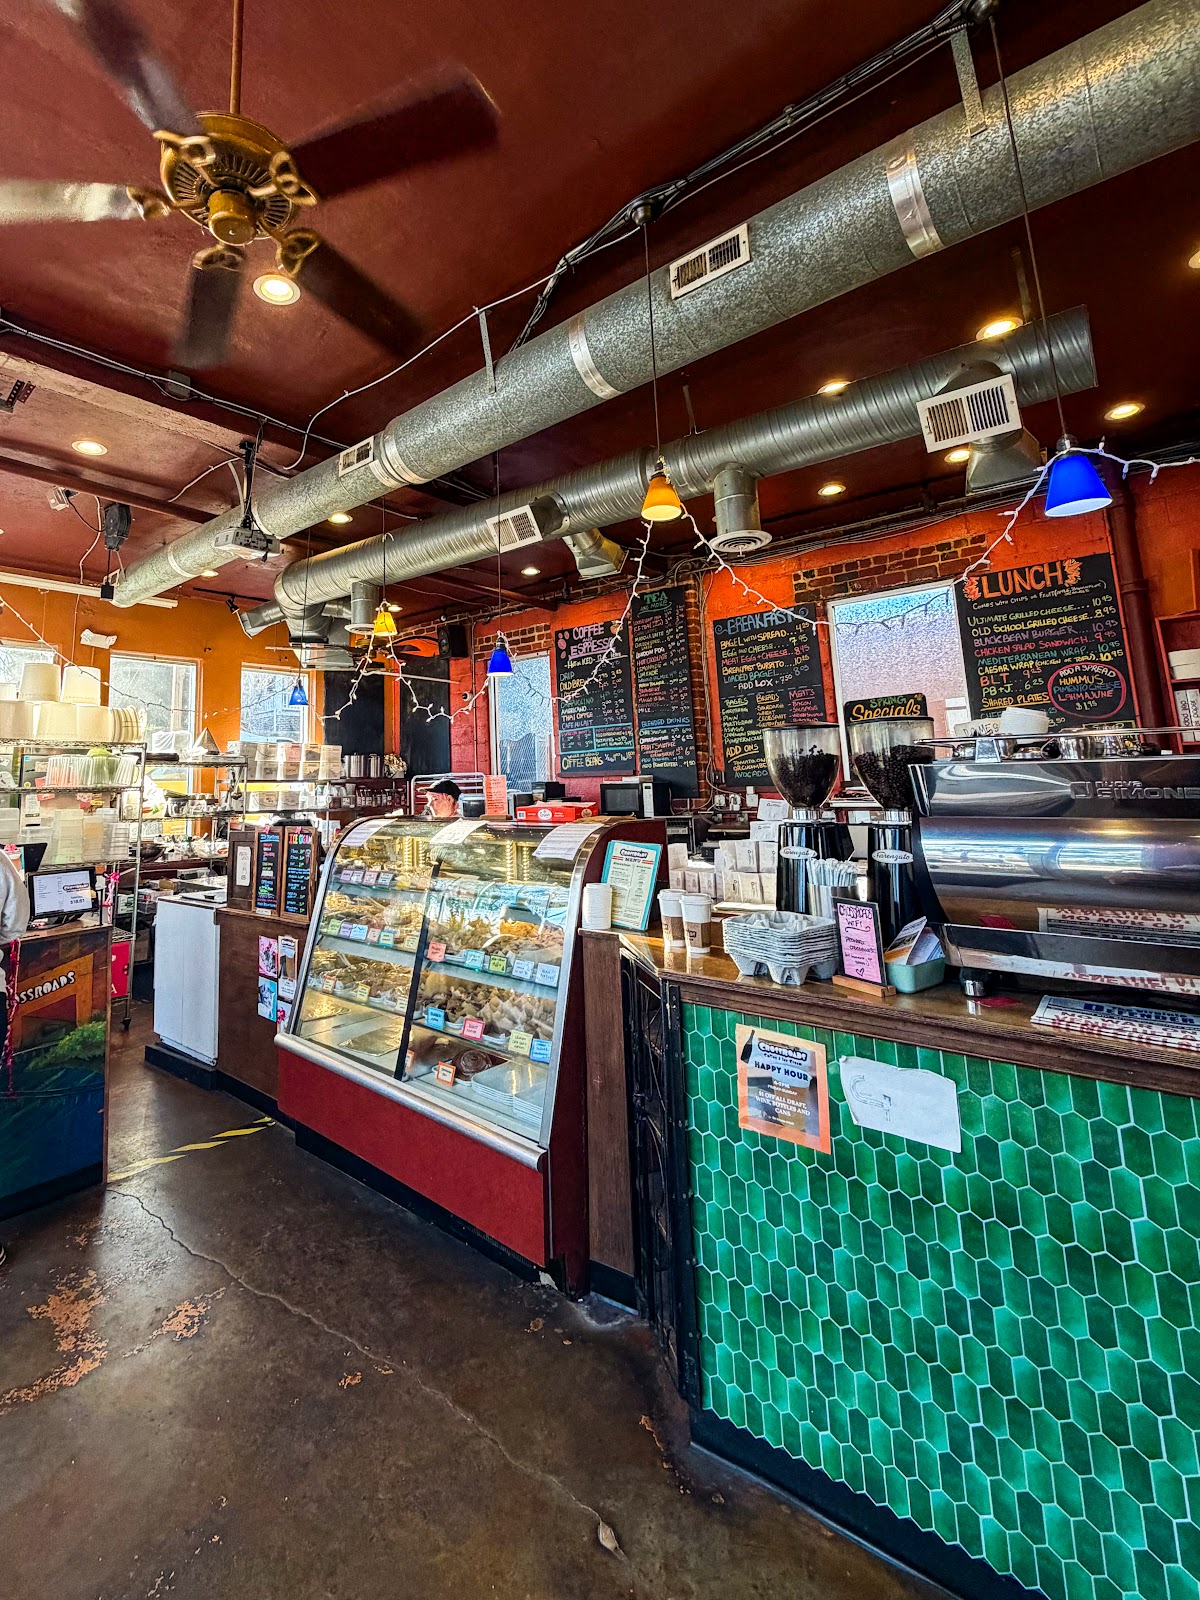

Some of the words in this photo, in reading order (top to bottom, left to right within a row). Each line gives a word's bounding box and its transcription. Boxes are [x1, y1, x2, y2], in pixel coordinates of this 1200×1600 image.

[982, 561, 1064, 598] LUNCH
[644, 591, 668, 604] TEA
[727, 608, 796, 635] BREAKFAST
[967, 614, 1008, 626] ULTIMATE
[1009, 610, 1039, 620] GRILLED
[572, 622, 604, 640] COFFEE
[972, 626, 991, 637] OLD
[993, 622, 1027, 633] SCHOOL
[1027, 617, 1058, 628] GRILLED
[720, 636, 744, 650] BAGEL
[758, 630, 787, 642] SPREAD
[974, 635, 1002, 647] BLACK
[1002, 630, 1029, 643] BEAN
[1032, 625, 1078, 639] BURGER
[721, 648, 738, 658] EGG
[748, 643, 774, 654] CHEESE
[974, 645, 1010, 658] CHICKEN
[1012, 642, 1036, 652] SALAD
[1039, 636, 1088, 649] SANDWICH
[721, 656, 739, 667] MEAT
[978, 650, 1057, 666] MEDITERRANEAN
[1060, 645, 1086, 656] WRAP
[722, 664, 756, 676] BREAKFAST
[756, 660, 784, 670] BURRITO
[978, 664, 1010, 676] CAESAR
[1010, 660, 1034, 671] WRAP
[1059, 668, 1074, 678] ADD
[1082, 664, 1116, 678] SPREAD
[723, 674, 748, 684] LOADED
[748, 669, 780, 680] BAGEL
[738, 682, 754, 690] ADD
[754, 678, 774, 688] LOX
[980, 672, 1010, 687] BLT
[1059, 674, 1104, 686] HUMMUS
[560, 681, 572, 692] COLD
[1053, 684, 1088, 694] PIMENTO
[1089, 681, 1122, 690] CHEESE
[788, 689, 816, 700] MEATS
[870, 696, 907, 708] SPRING
[982, 696, 1014, 708] SHARED
[1016, 692, 1050, 704] PLATES
[850, 698, 921, 722] Specials
[641, 718, 664, 728] BLENDED
[666, 716, 690, 724] DRINKS
[726, 746, 742, 758] ADD
[744, 744, 758, 752] ONS
[562, 756, 584, 770] COFFEE
[734, 770, 768, 778] AVOCADO
[289, 834, 298, 844] ICE
[754, 1060, 782, 1074] HAPPY
[784, 1068, 809, 1082] HOUR
[774, 1108, 790, 1116] CANS
[797, 1108, 810, 1116] AND
